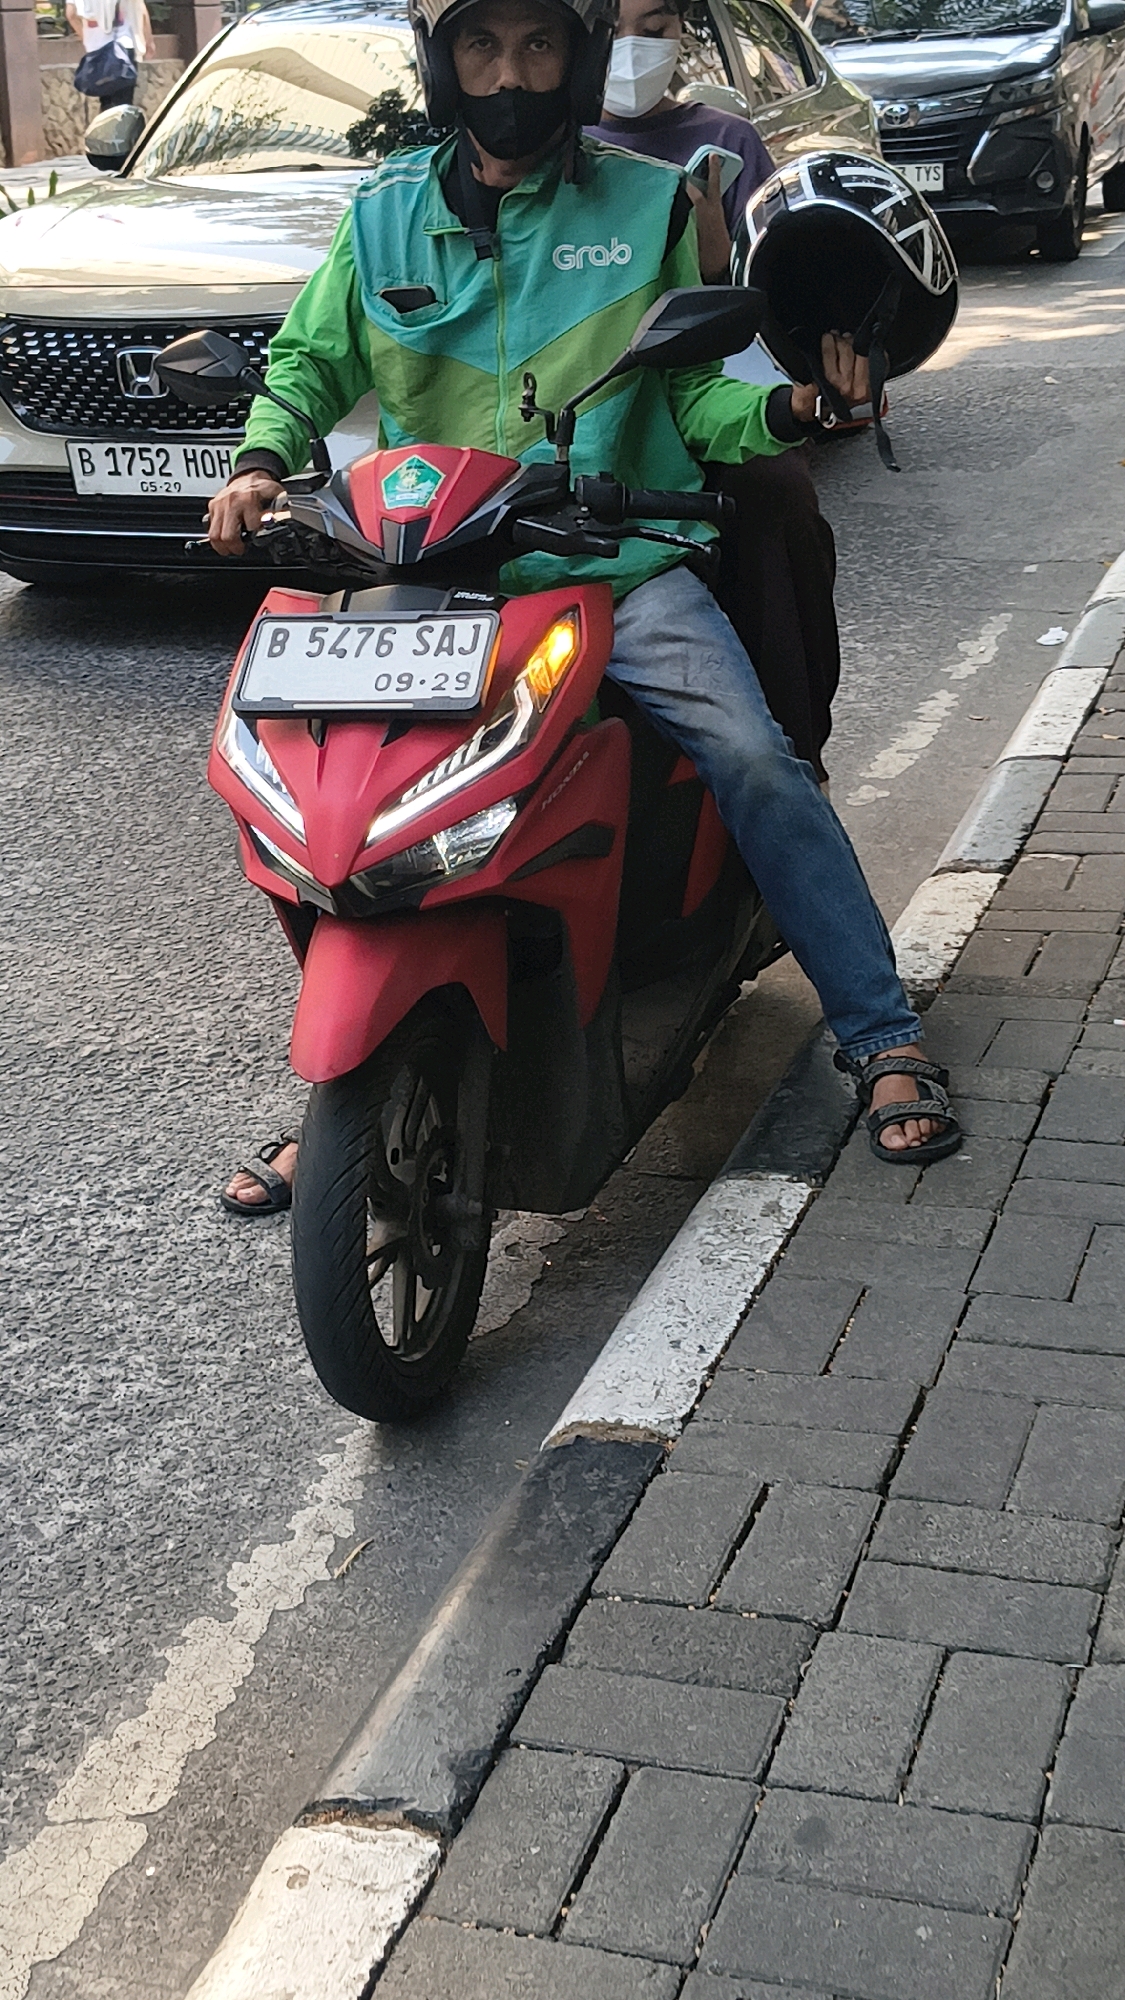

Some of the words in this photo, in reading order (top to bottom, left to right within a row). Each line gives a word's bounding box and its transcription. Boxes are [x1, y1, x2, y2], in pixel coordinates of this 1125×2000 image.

[914, 165, 941, 182] TYS
[552, 237, 633, 271] Grab
[77, 447, 96, 477] B
[104, 447, 173, 477] 1752
[183, 448, 232, 479] HOH
[266, 627, 290, 658] B
[305, 626, 397, 659] 5476
[412, 623, 482, 657] SAJ
